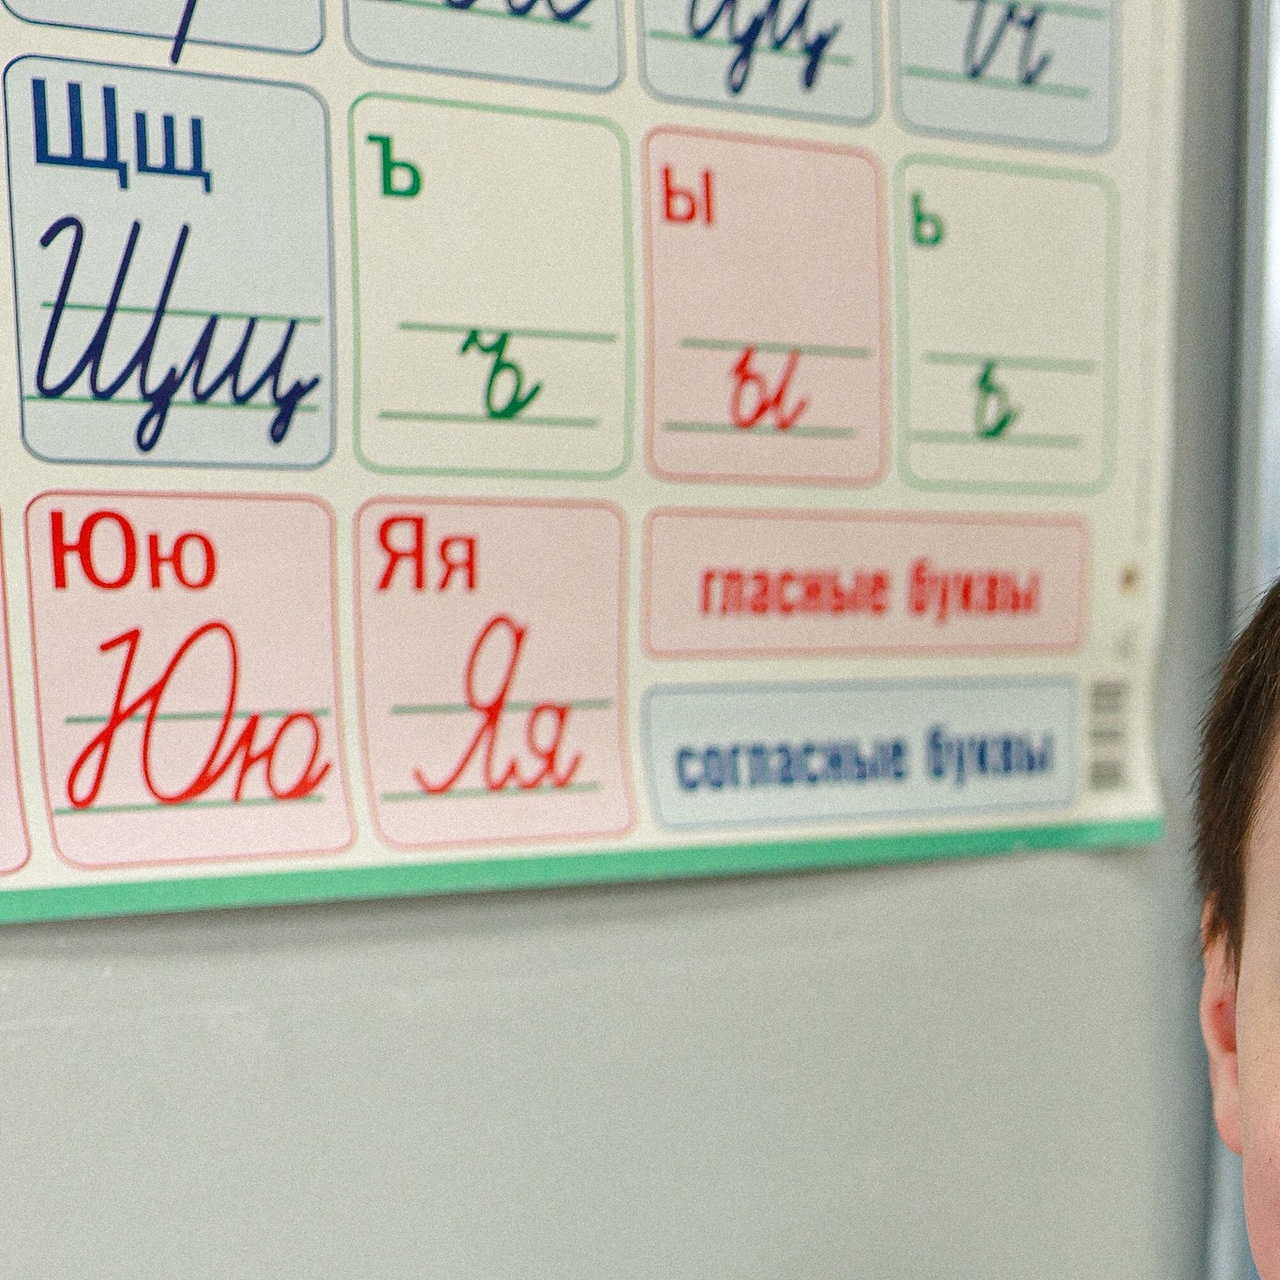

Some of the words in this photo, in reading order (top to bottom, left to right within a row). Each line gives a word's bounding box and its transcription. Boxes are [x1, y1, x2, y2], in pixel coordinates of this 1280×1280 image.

[32, 78, 212, 194] Щщ
[40, 215, 320, 452] Щщ
[50, 510, 217, 590] Юю
[375, 515, 477, 593] Яя
[701, 565, 890, 617] гласные
[909, 556, 1042, 626] буквы
[66, 621, 331, 810] Юю
[413, 612, 584, 795] Яя
[674, 738, 909, 793] согласные
[924, 722, 1056, 789] буквы
